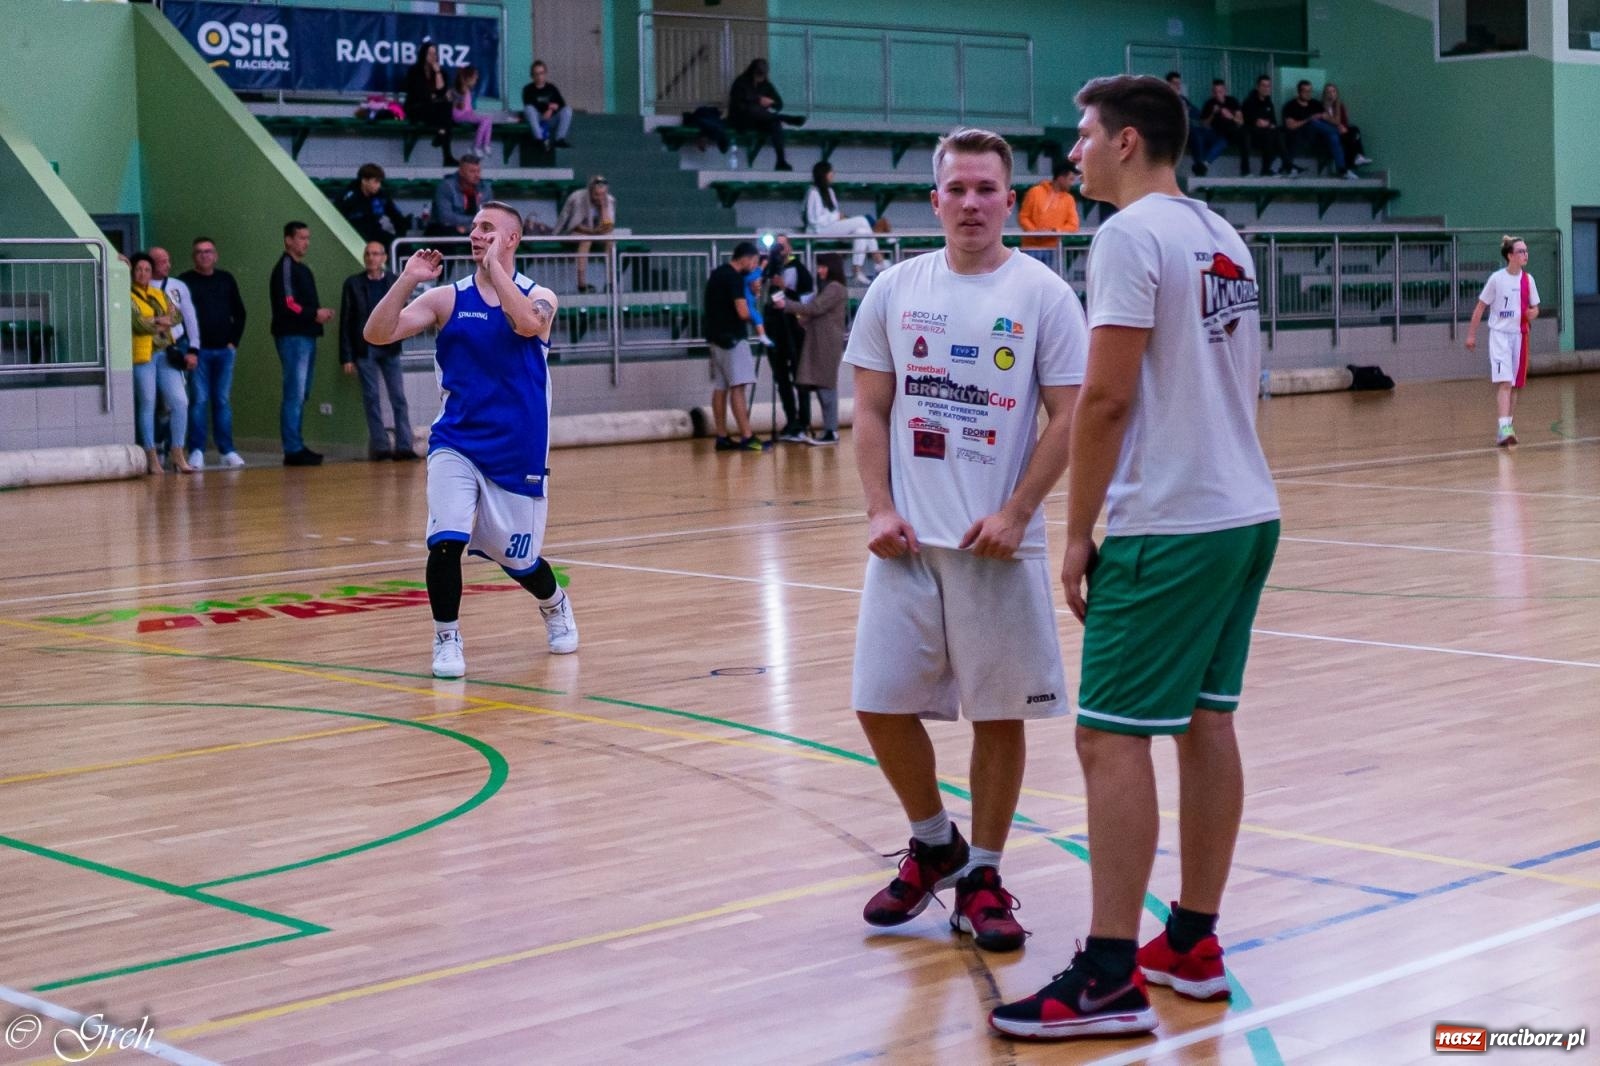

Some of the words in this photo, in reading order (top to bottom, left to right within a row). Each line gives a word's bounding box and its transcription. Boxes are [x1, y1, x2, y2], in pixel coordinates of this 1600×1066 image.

[197, 20, 289, 57] OSiR
[336, 36, 470, 67] RACIBRZ
[235, 58, 290, 71] RACIBÓRZ
[932, 314, 948, 322] LAT
[906, 364, 946, 375] Streetball
[989, 393, 1016, 411] Cup
[951, 405, 989, 417] DYREKTORA
[505, 533, 531, 559] 30
